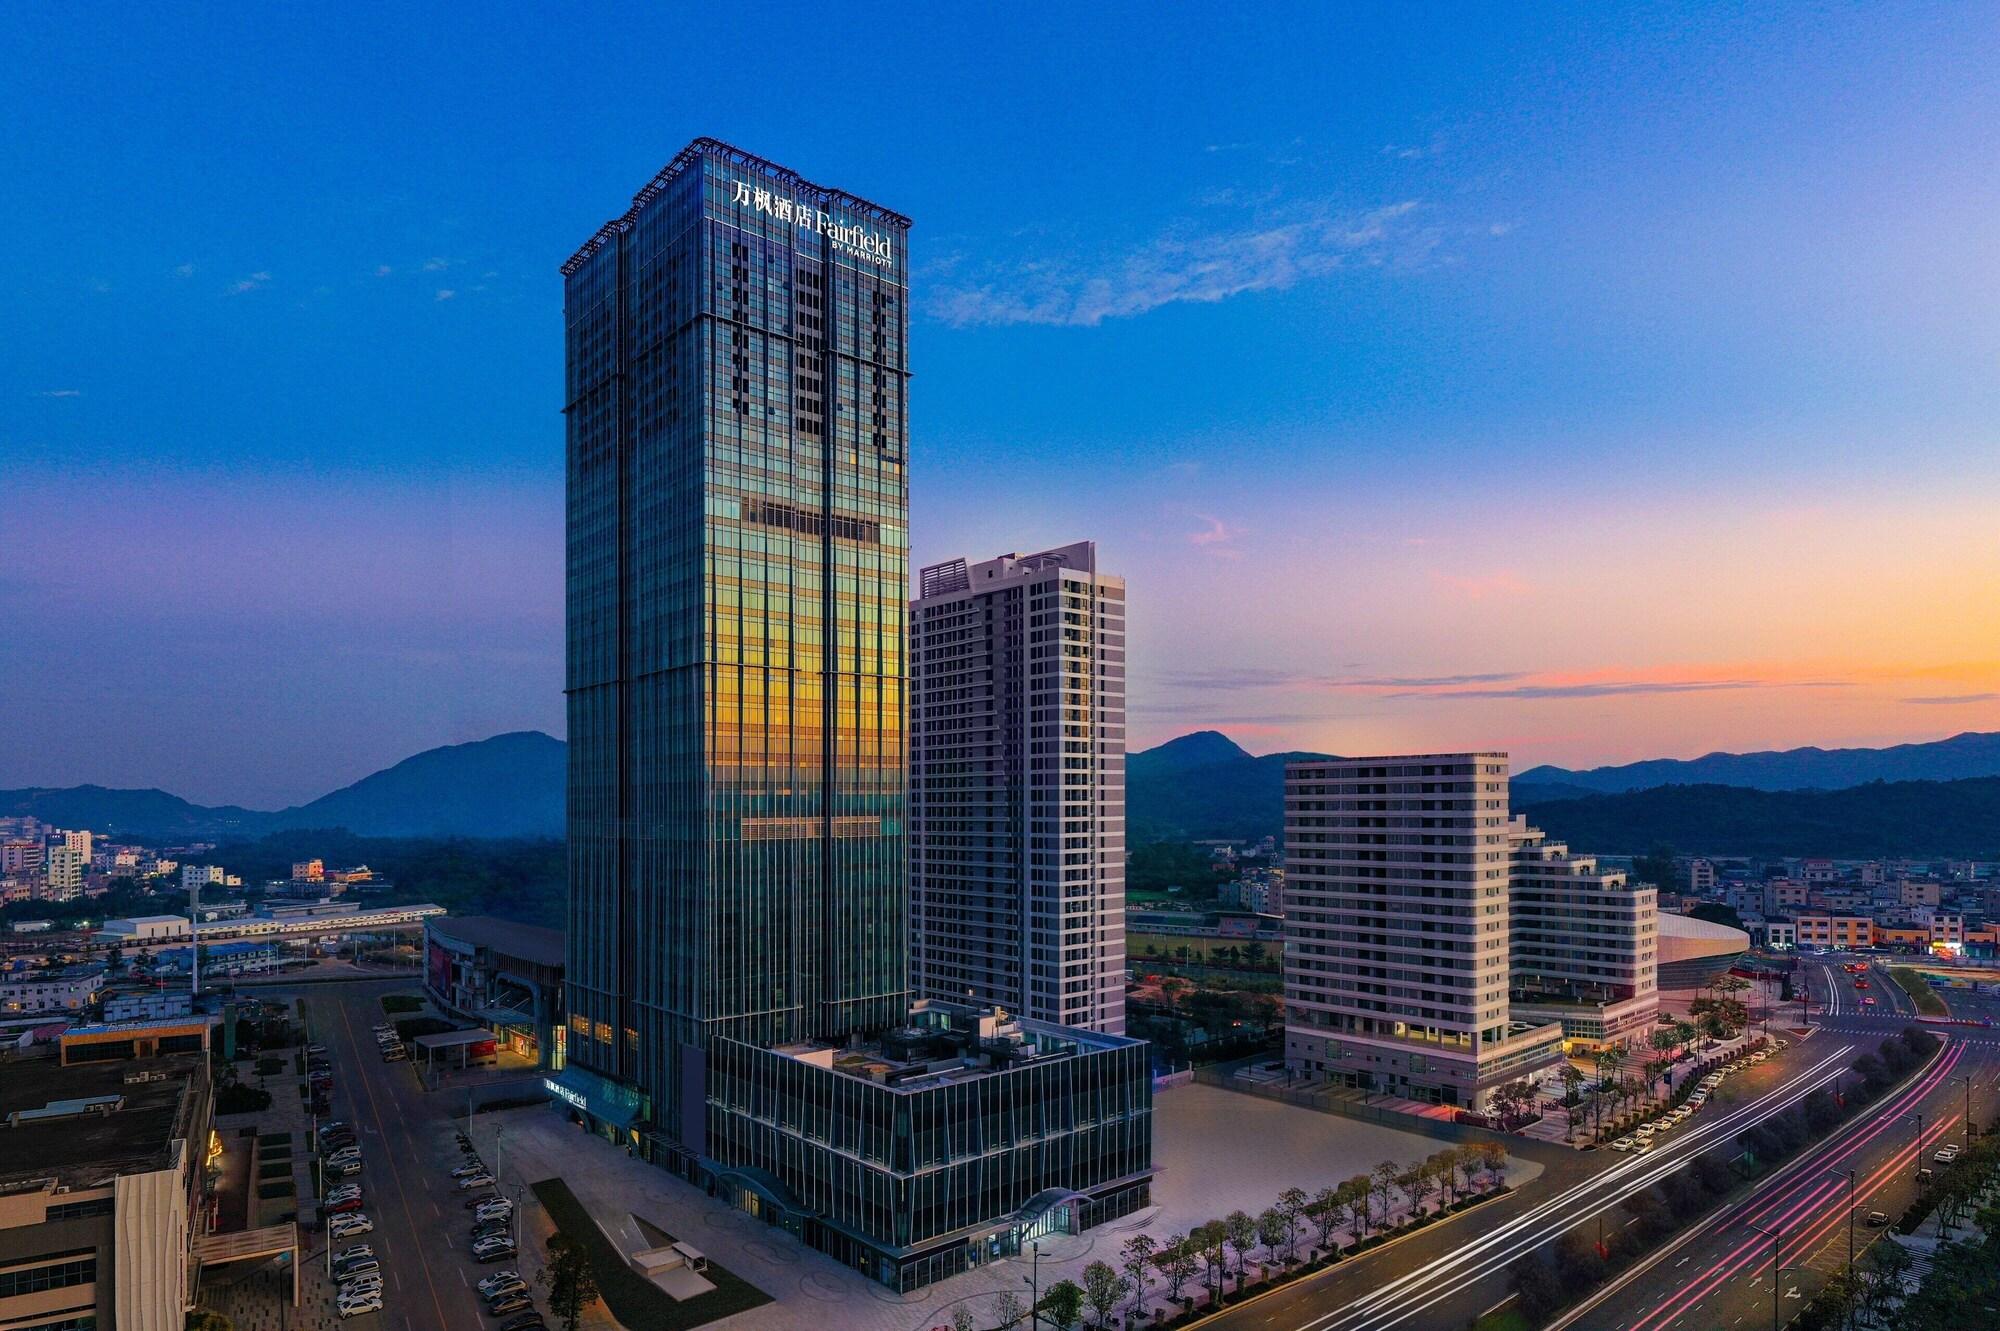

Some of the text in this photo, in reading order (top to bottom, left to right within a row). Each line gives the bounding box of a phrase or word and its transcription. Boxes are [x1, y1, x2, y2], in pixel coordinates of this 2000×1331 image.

[732, 179, 892, 260] 万枫酒店 Fairfield
[832, 240, 893, 268] BY MARRIOTT
